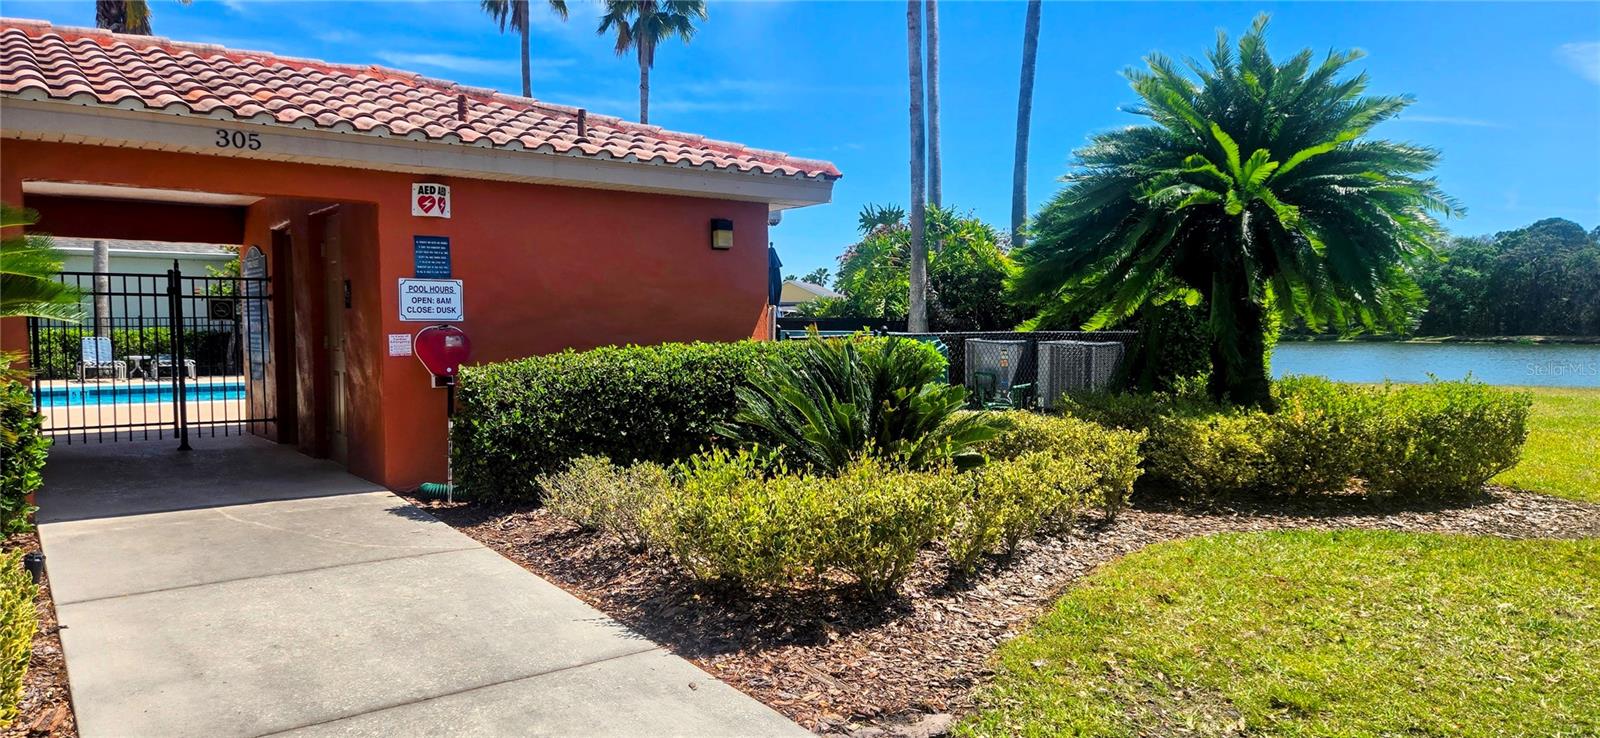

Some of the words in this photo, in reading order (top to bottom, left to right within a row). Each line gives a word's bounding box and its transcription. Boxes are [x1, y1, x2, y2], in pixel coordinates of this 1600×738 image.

[215, 129, 261, 150] 305
[417, 185, 436, 195] AED
[408, 285, 429, 294] POOL
[429, 286, 454, 294] HOURS
[406, 306, 435, 314] CLOSE:
